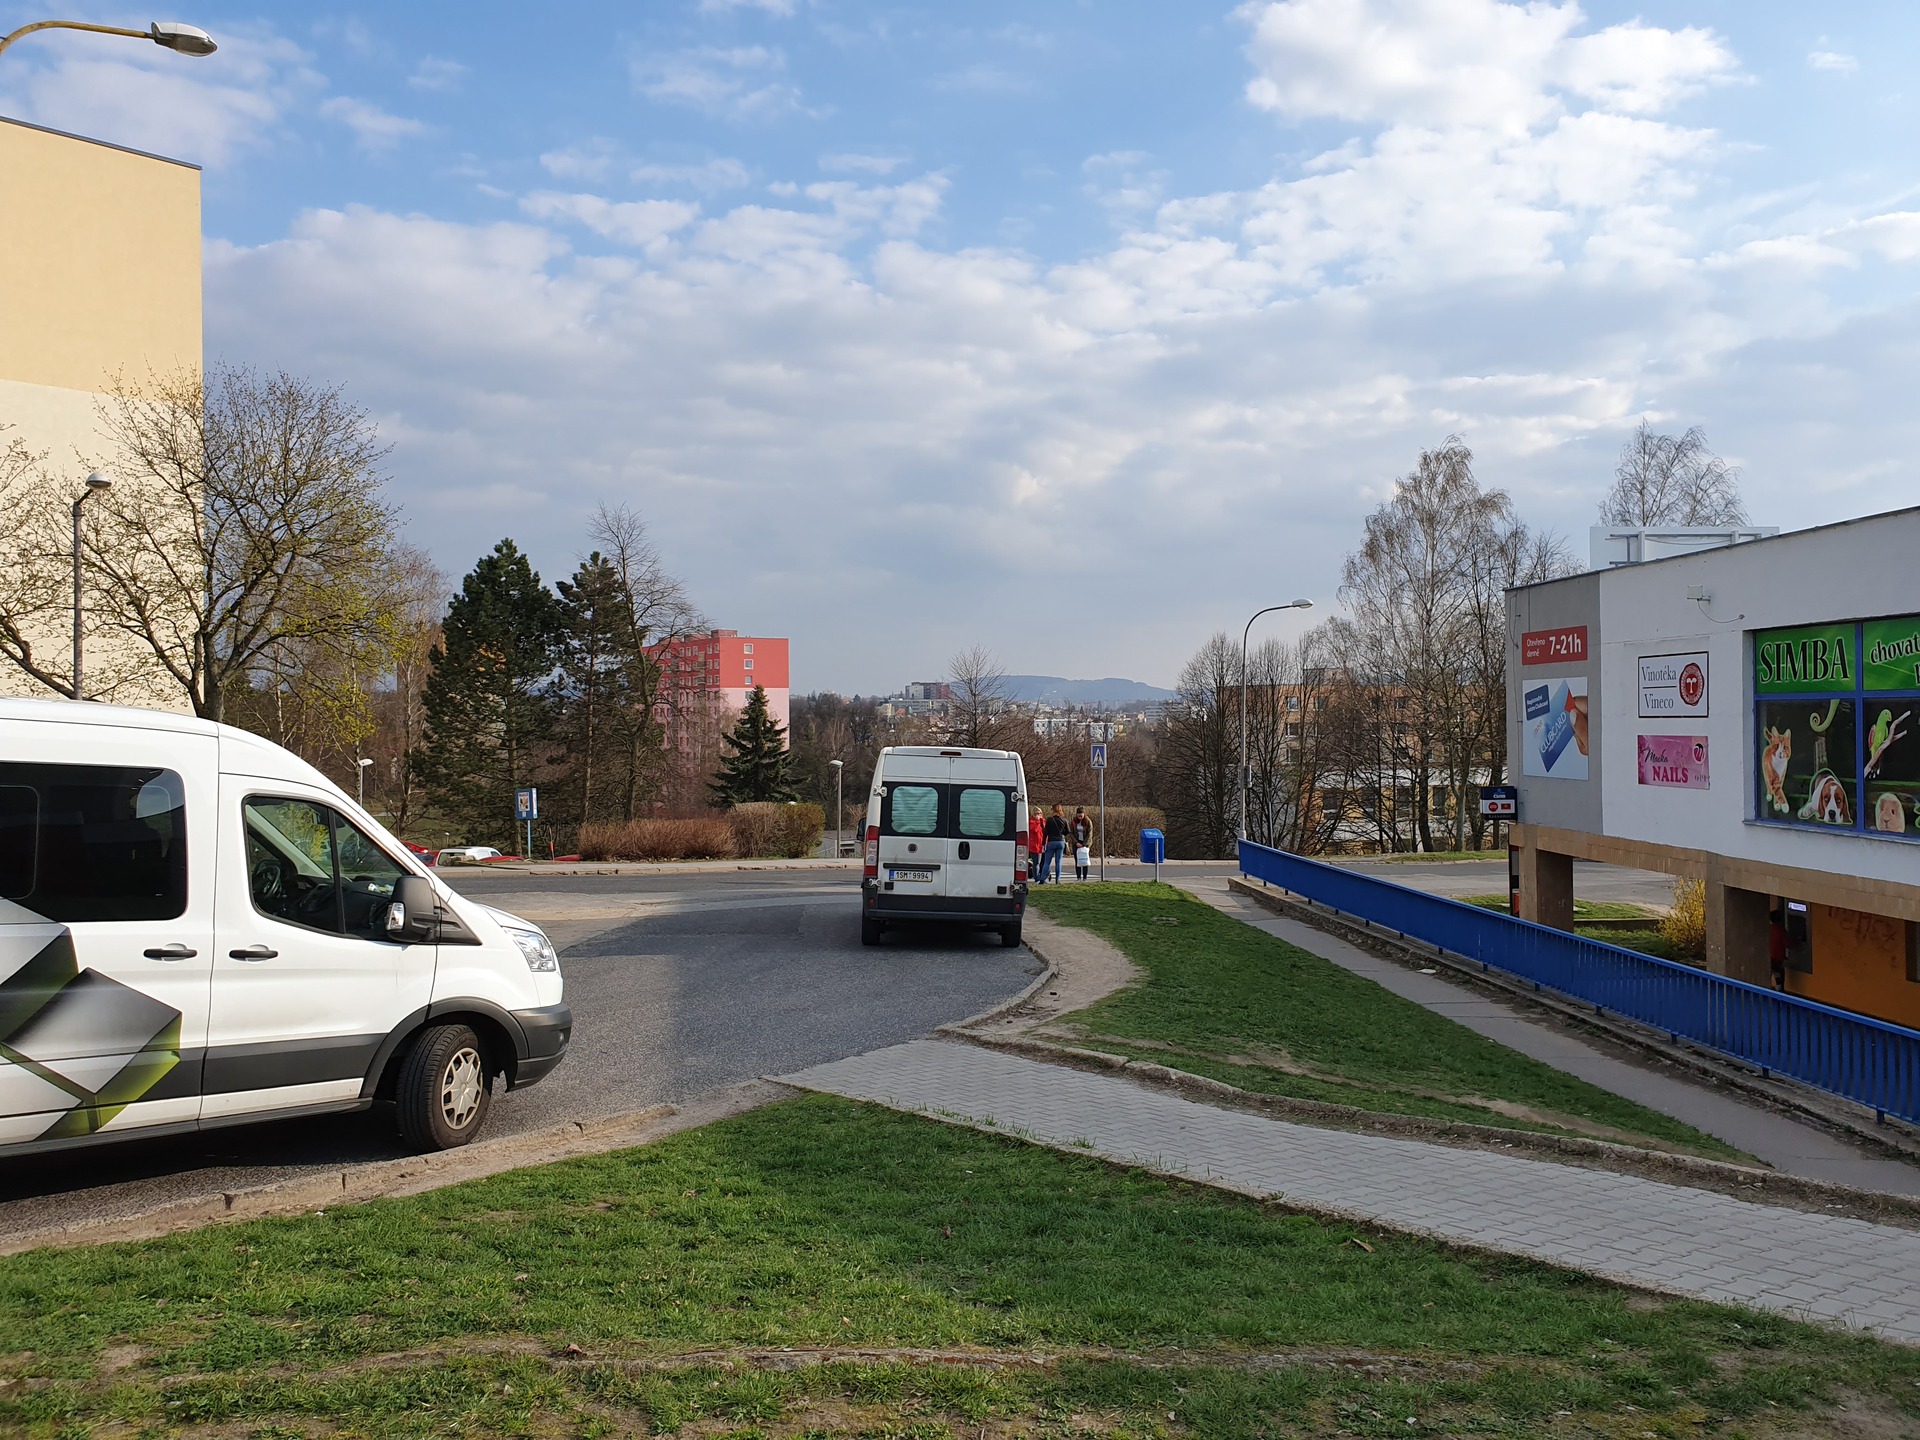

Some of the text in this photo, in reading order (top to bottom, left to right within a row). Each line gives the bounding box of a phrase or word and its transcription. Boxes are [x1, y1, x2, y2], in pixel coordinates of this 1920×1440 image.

[1549, 633, 1582, 656] 7-21h
[1760, 637, 1850, 683] SIMBA
[1641, 665, 1677, 682] Vinotéka
[1644, 693, 1674, 709] Vineco
[1541, 711, 1567, 753] CLUBCARD
[1652, 765, 1689, 784] NAILS
[912, 872, 929, 880] 9994
